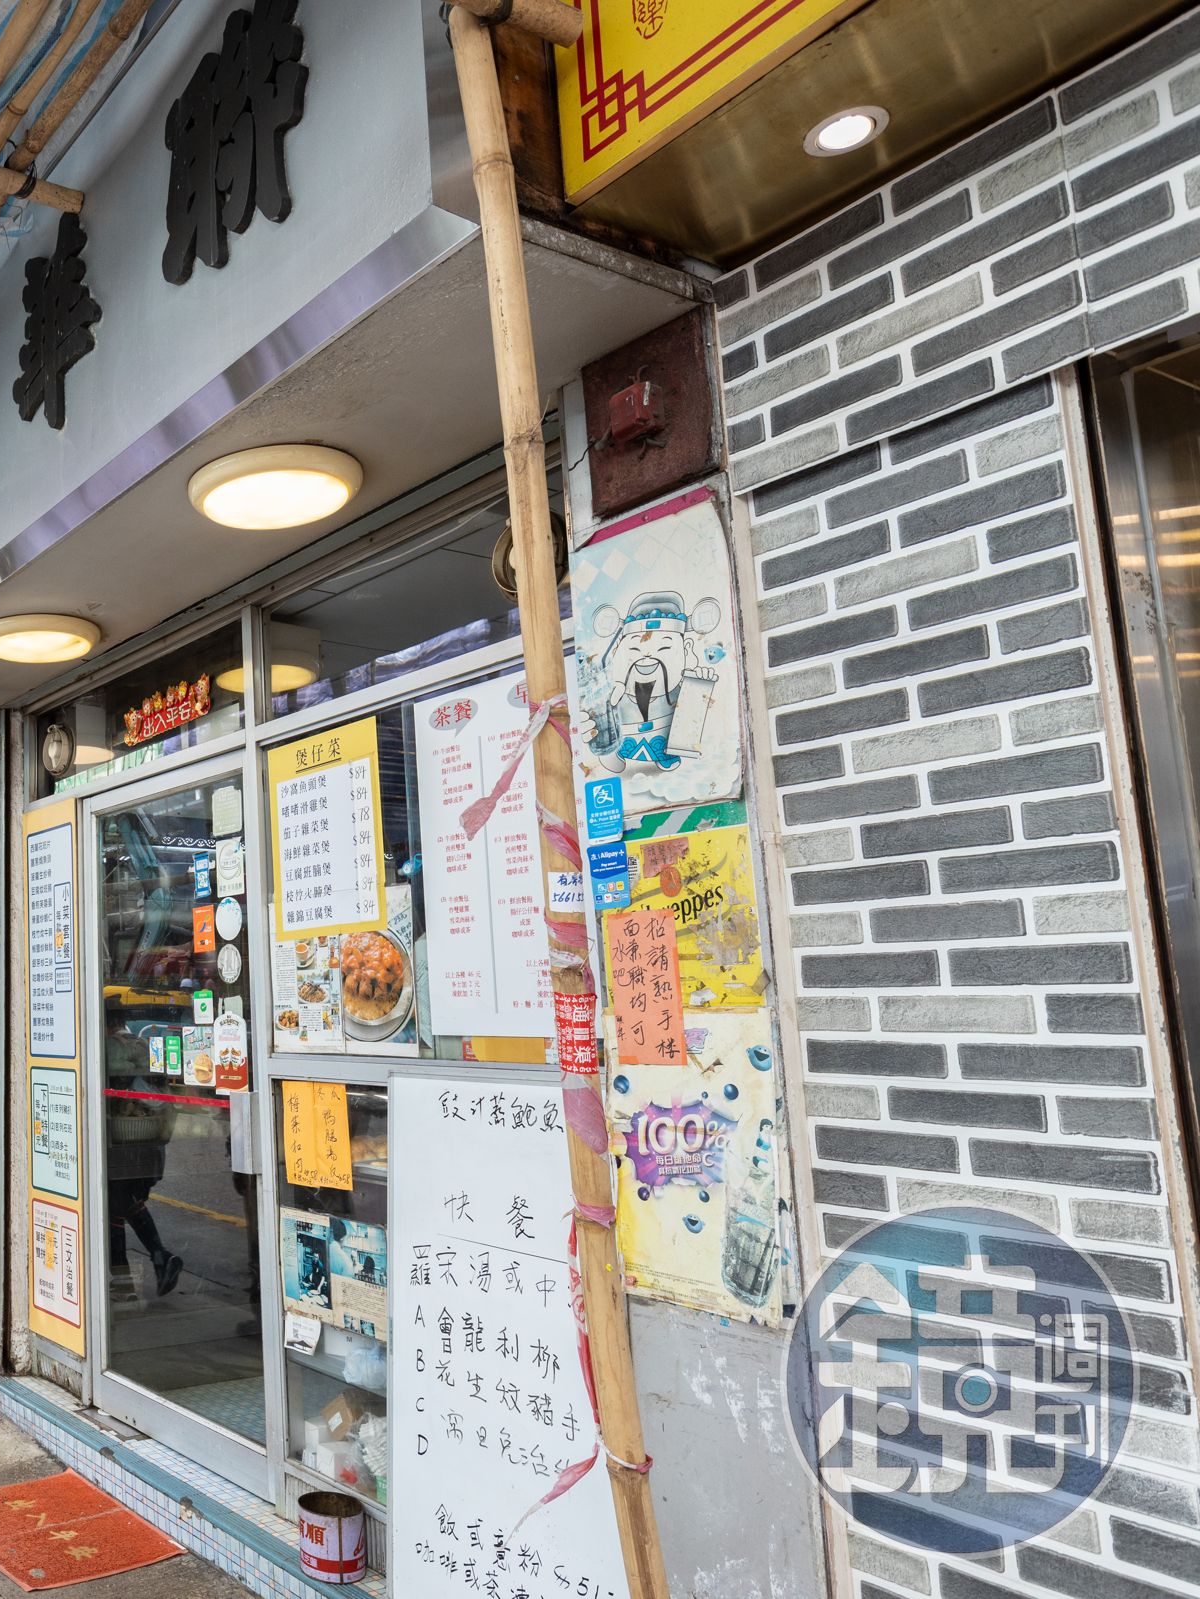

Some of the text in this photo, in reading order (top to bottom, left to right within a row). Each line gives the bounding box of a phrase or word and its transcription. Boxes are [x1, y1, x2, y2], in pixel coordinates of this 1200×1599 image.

[144, 701, 192, 737] 出入平安
[433, 699, 473, 728] 茶餐
[295, 737, 341, 768] 煲仔菜
[443, 796, 464, 806] 咖啡或茶
[501, 804, 524, 814] 咖啡或茶
[284, 840, 330, 862] 海鮮雜菜煲
[447, 864, 468, 873] 咖啡或茶
[506, 866, 529, 876] 咖啡或茶
[450, 927, 472, 935] 咖啡或茶
[511, 930, 536, 938] 咖啡或茶
[40, 1088, 48, 1148] 下午特餐
[637, 1113, 727, 1157] 100%
[444, 1190, 536, 1239] 快餐
[65, 1232, 73, 1298] 三文治餐
[409, 1244, 571, 1308] 羅宋湯或中
[415, 1305, 425, 1328] A
[415, 1350, 425, 1373] B
[415, 1397, 425, 1413] C
[417, 1433, 429, 1456] D
